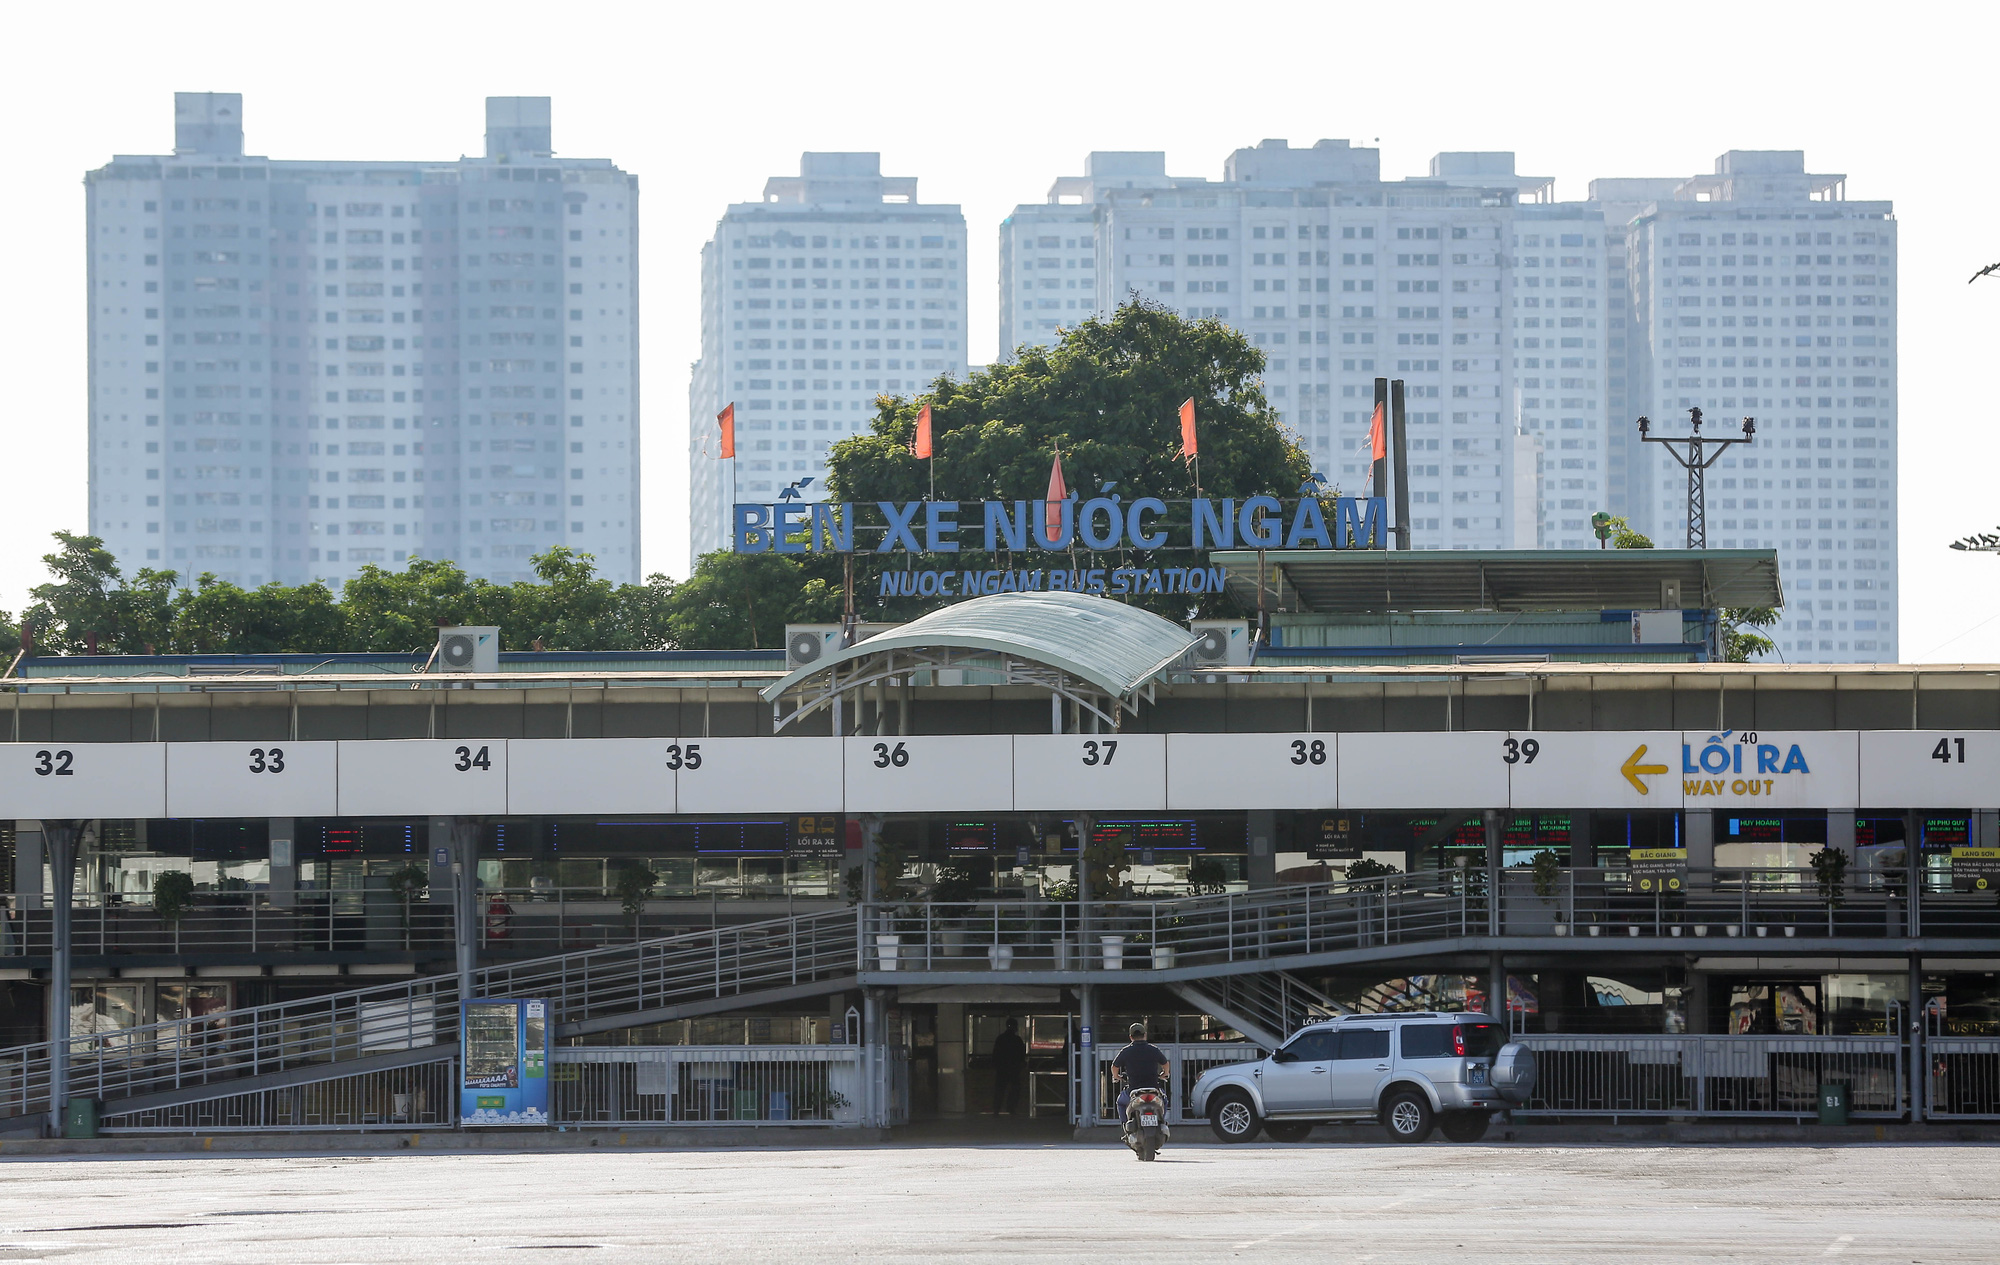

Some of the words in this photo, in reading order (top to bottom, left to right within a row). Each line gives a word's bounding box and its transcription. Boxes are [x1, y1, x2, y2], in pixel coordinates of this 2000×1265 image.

[734, 477, 853, 553] BẾN
[877, 500, 960, 552] XE
[984, 481, 1168, 550] NƯỚC
[1191, 472, 1388, 549] NGẦM
[880, 570, 956, 596] NUOC
[962, 569, 1041, 595] NGAM
[1049, 569, 1105, 594] BUS
[1110, 567, 1226, 594] STATION
[1502, 738, 1540, 764] 39
[1682, 729, 1741, 774] LỐI
[1757, 744, 1810, 774] RA
[1740, 732, 1757, 745] 40
[1931, 737, 1965, 764] 41
[35, 750, 74, 776] 32
[248, 748, 285, 774] 33
[454, 745, 491, 772] 34
[665, 744, 702, 770] 35
[873, 742, 910, 768] 36
[1082, 740, 1118, 766] 37
[1290, 739, 1327, 766] 38
[1683, 780, 1725, 795] WAY
[1732, 780, 1774, 795] OUT
[797, 835, 810, 845] LỐI
